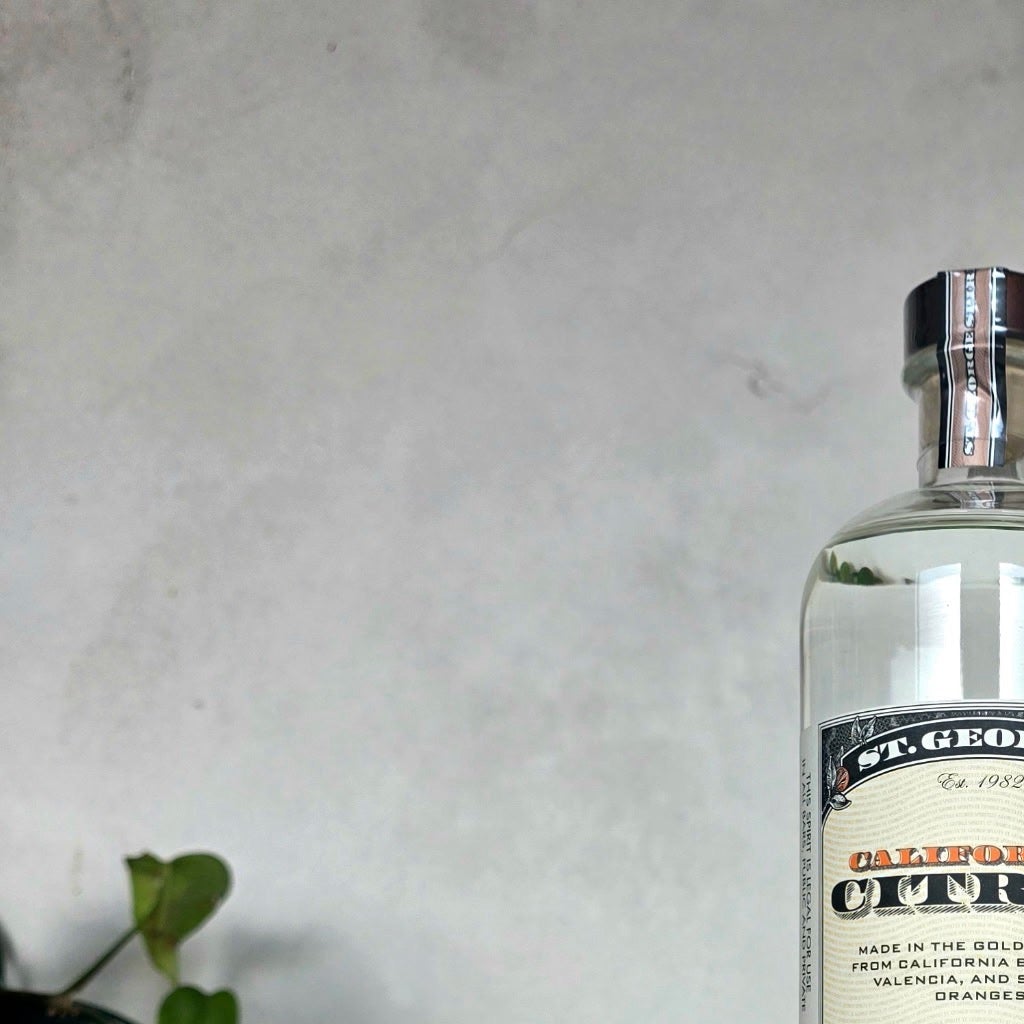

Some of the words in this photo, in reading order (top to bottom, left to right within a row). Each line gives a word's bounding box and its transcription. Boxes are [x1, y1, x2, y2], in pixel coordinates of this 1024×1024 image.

[858, 738, 917, 771] ST.
[937, 773, 968, 790] Est.
[806, 859, 812, 872] IS
[859, 944, 901, 954] MADE
[907, 942, 924, 952] IN
[931, 941, 966, 951] THE
[852, 960, 894, 971] FROM
[898, 957, 1008, 969] CALIFORNIA
[874, 974, 964, 987] VALENCIA,
[971, 974, 1010, 984] AND
